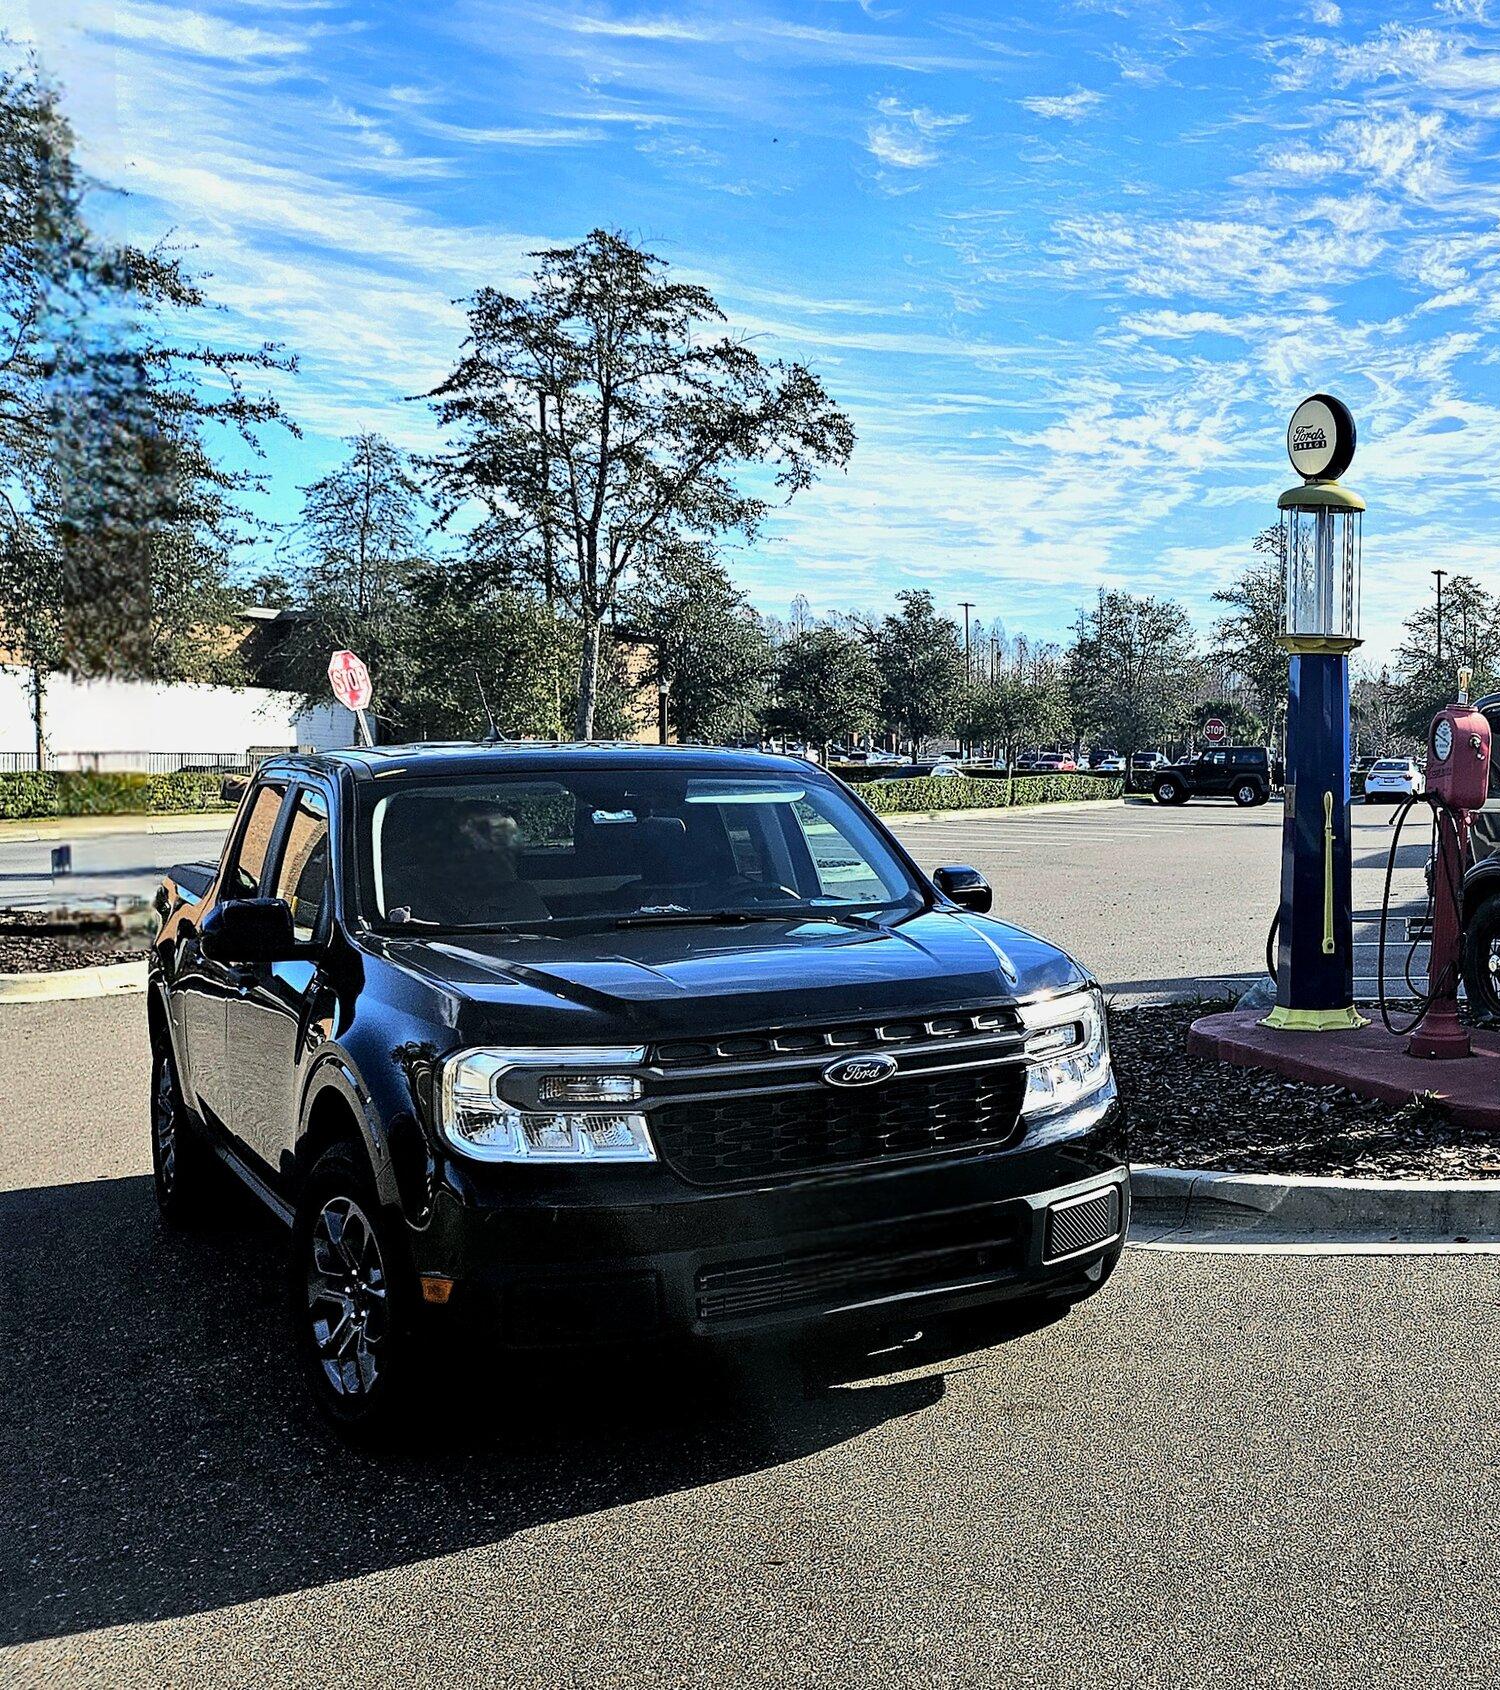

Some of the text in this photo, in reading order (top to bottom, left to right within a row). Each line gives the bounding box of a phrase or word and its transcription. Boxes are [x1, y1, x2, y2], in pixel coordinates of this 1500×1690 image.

[1293, 425, 1326, 442] Ford's
[1294, 441, 1325, 450] GARAGE
[331, 667, 368, 694] STOP
[1206, 725, 1224, 735] STOP
[843, 1063, 881, 1081] Ford
